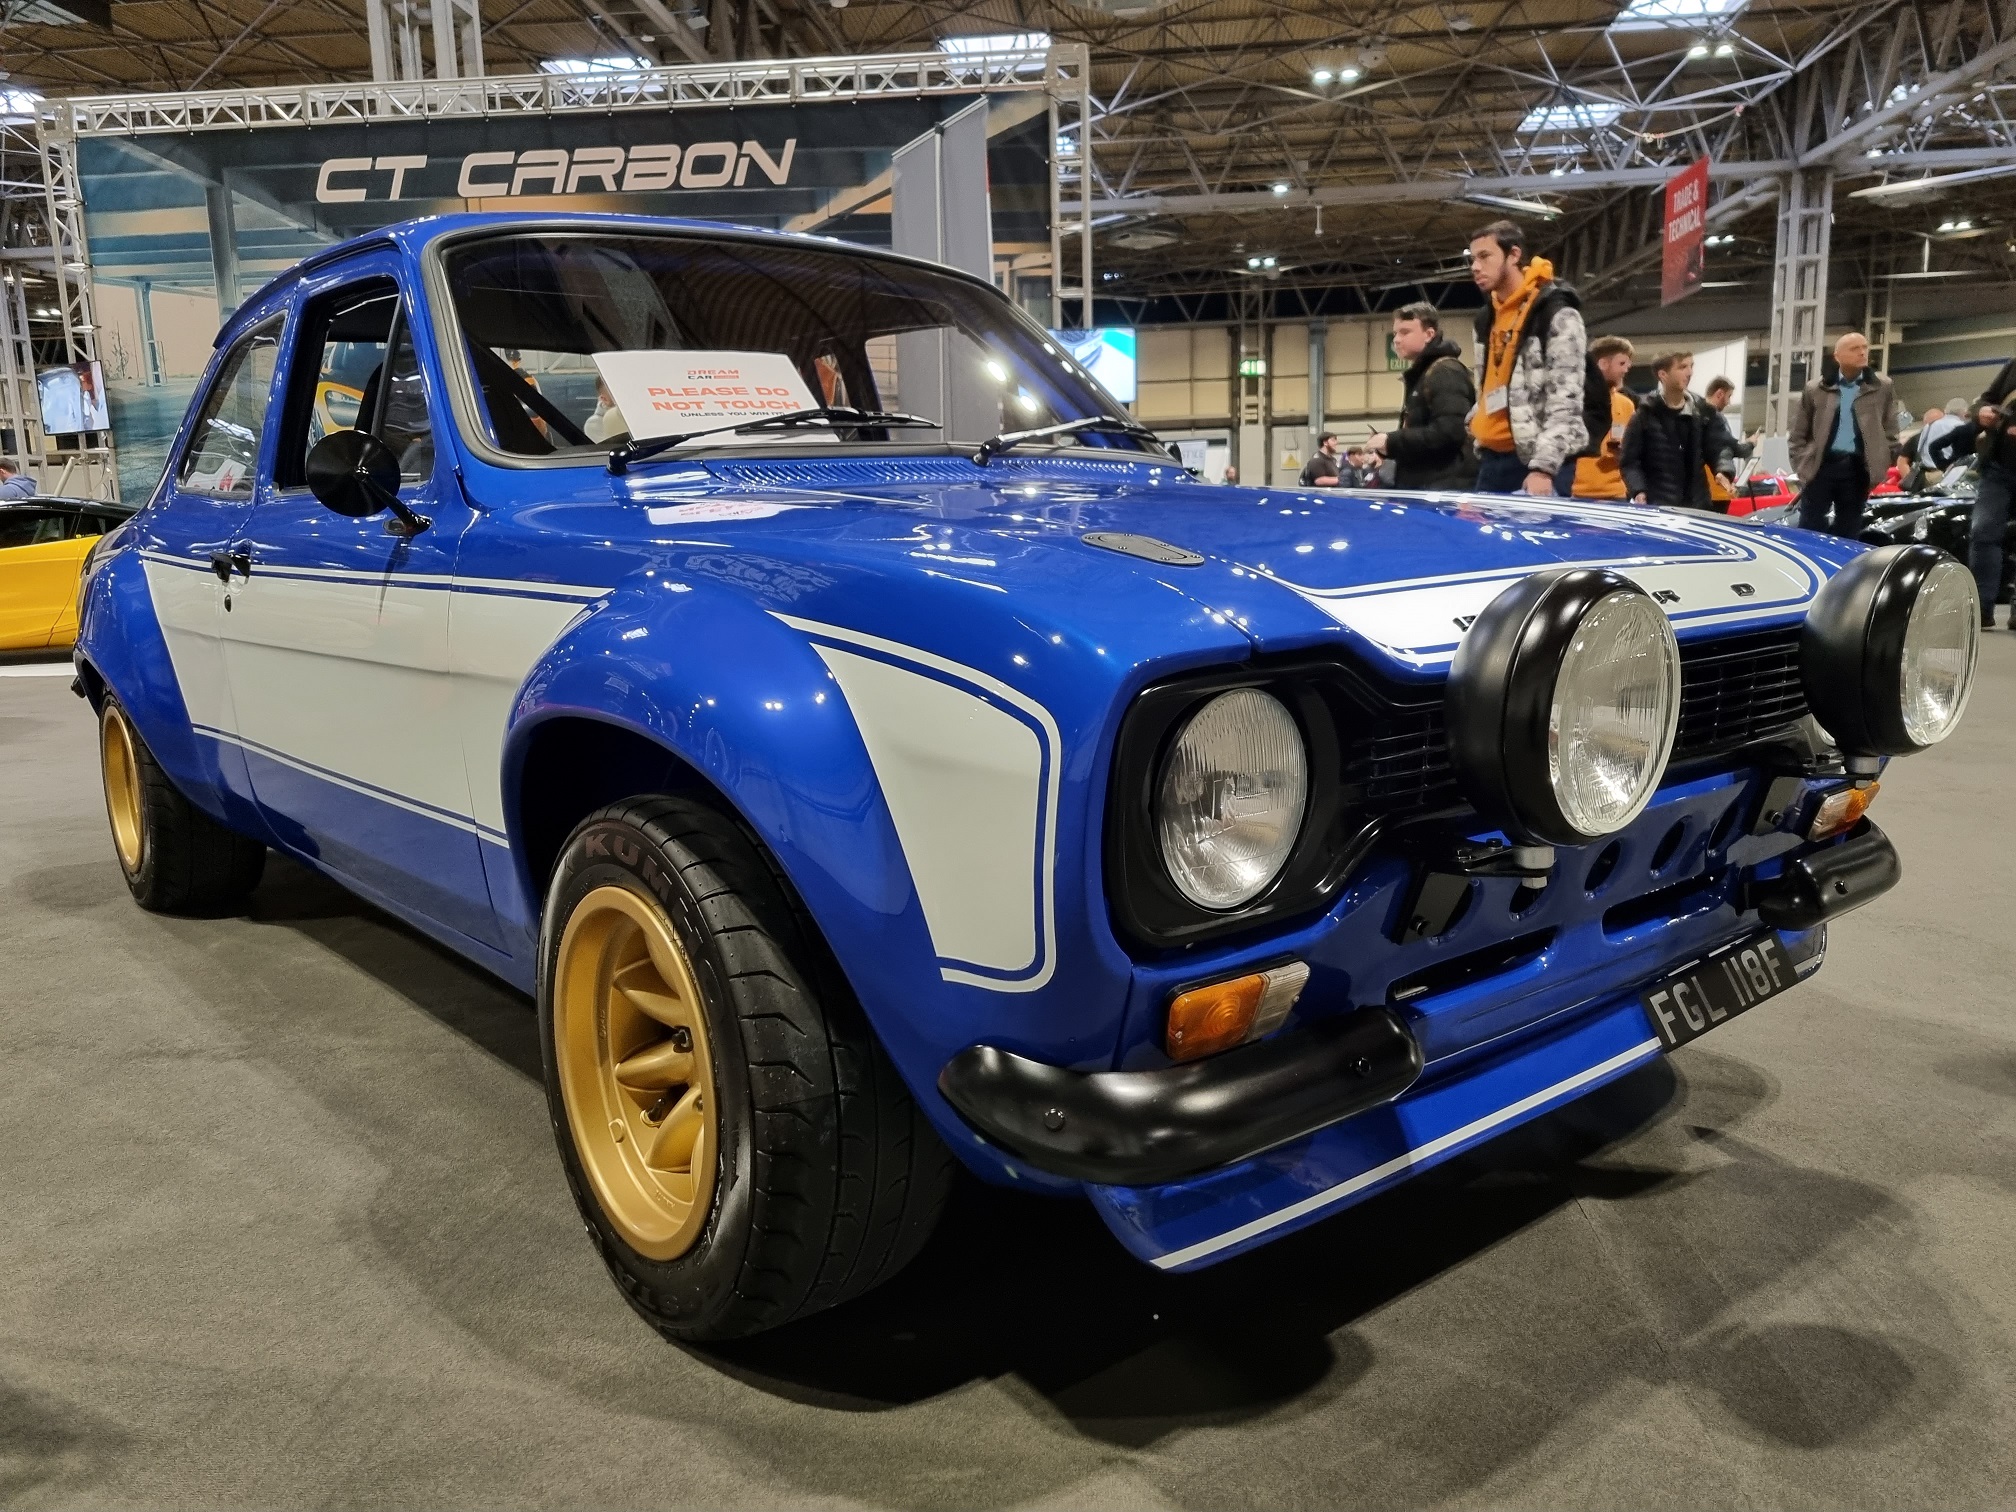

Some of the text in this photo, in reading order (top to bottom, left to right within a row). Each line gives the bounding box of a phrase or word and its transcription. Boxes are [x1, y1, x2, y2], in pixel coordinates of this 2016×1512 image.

[315, 138, 797, 203] CT CARBON
[1673, 178, 1699, 213] TRADE &
[1668, 205, 1702, 243] TECHNICAL
[647, 387, 790, 397] PLEASE DO
[652, 401, 801, 411] NOT TOUCH
[1649, 938, 1782, 1044] FGL 118F
